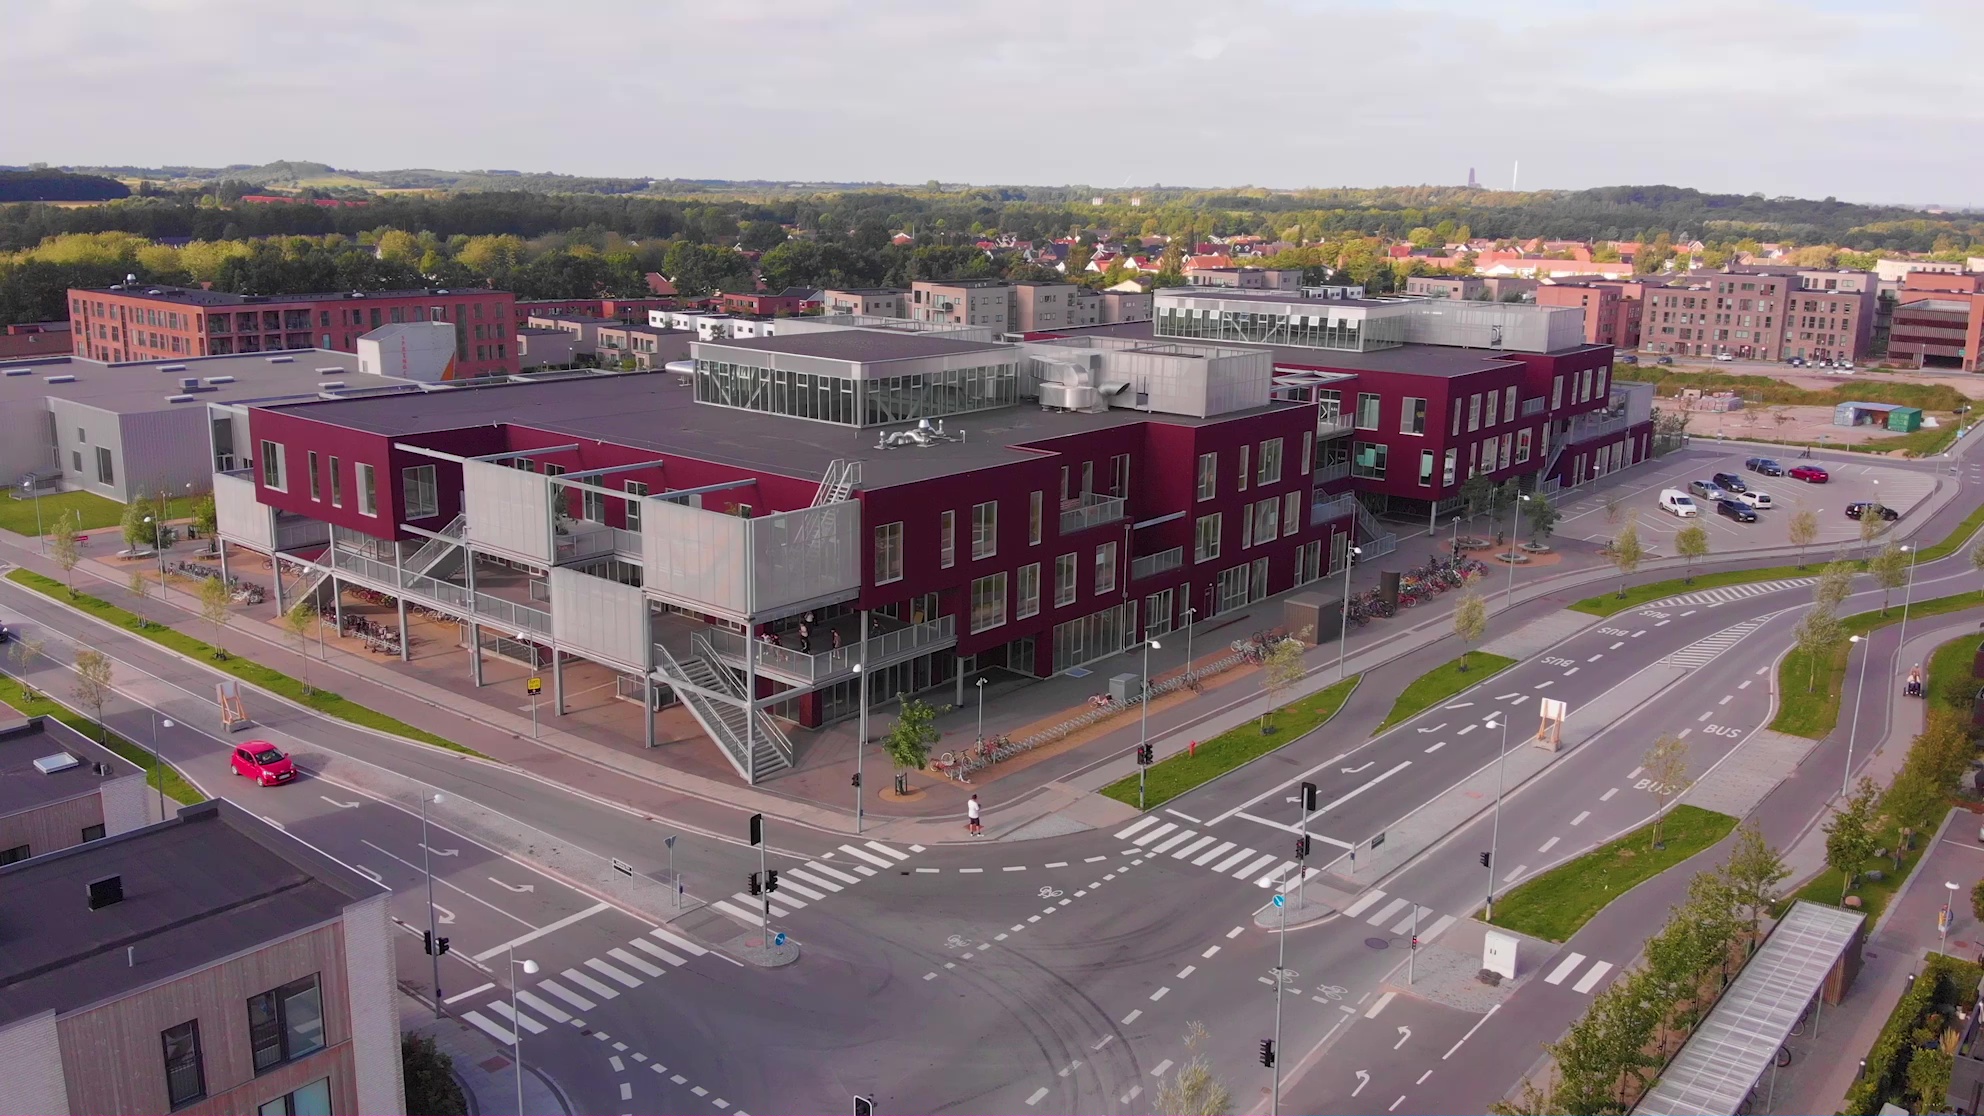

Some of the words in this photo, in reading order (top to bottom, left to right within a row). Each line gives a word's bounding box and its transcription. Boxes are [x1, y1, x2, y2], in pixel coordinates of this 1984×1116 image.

[1638, 610, 1671, 619] BUS
[1597, 627, 1630, 637] BUS
[1541, 656, 1575, 667] BUS
[1702, 724, 1742, 738] BUS
[1633, 779, 1676, 795] BUS
